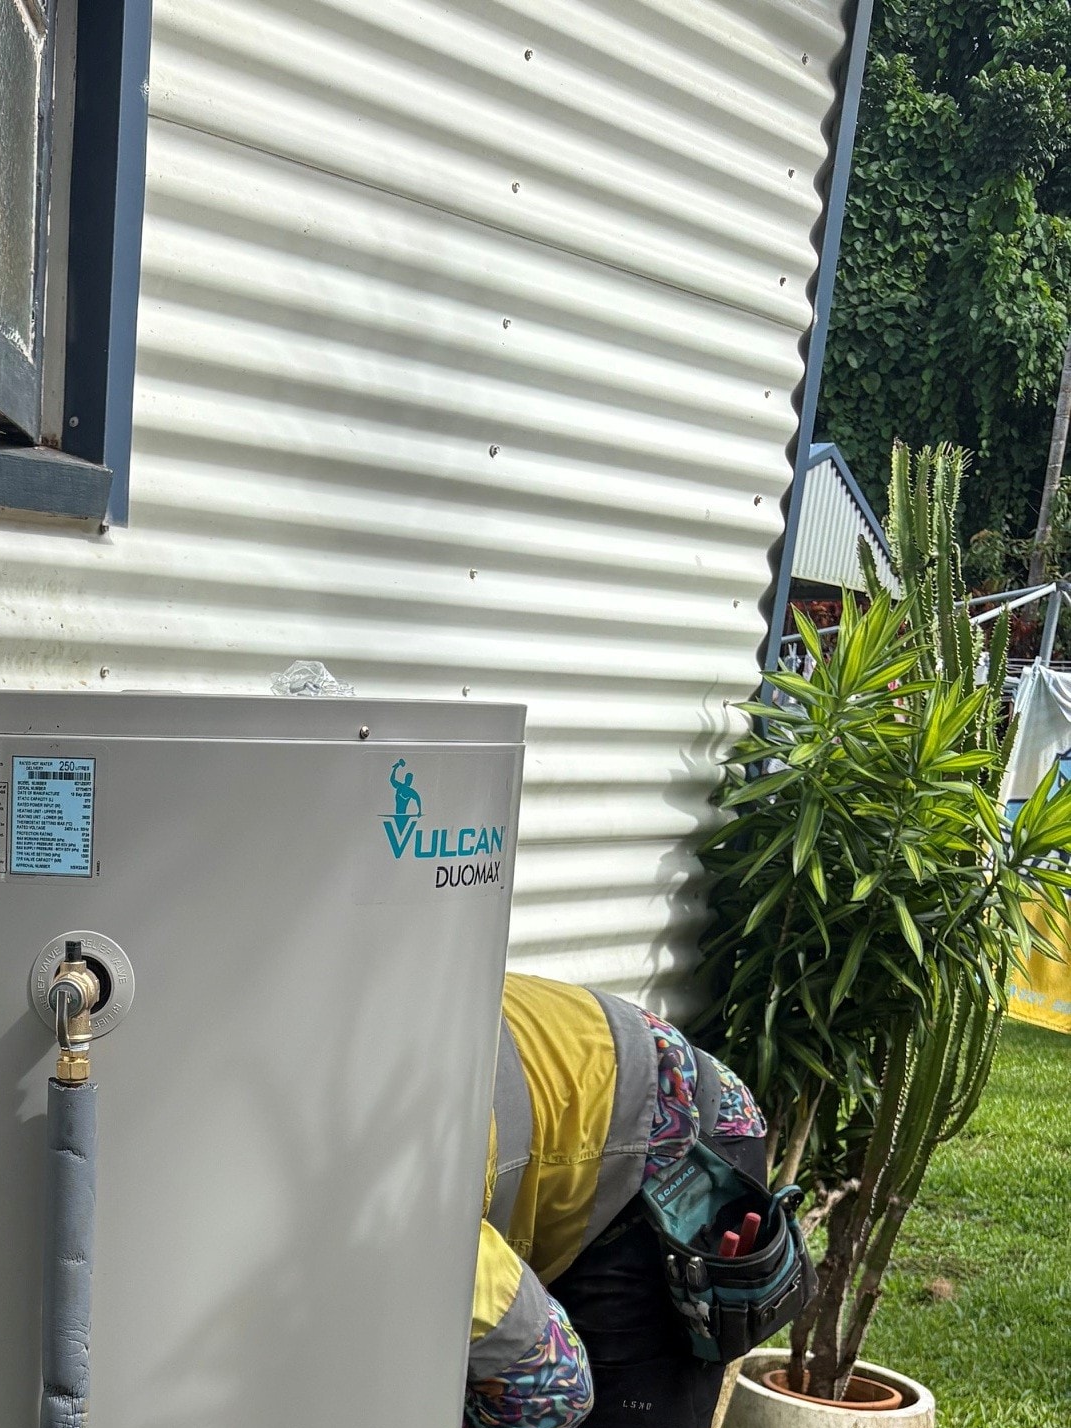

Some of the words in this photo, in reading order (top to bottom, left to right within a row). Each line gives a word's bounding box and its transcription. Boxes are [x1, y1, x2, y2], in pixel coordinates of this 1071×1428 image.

[59, 761, 75, 771] 250
[384, 821, 504, 859] VULCAN
[435, 861, 500, 888] DUOMAX
[39, 946, 62, 974] VALVE
[80, 938, 112, 956] RELIEF
[36, 975, 50, 1011] RELIEF
